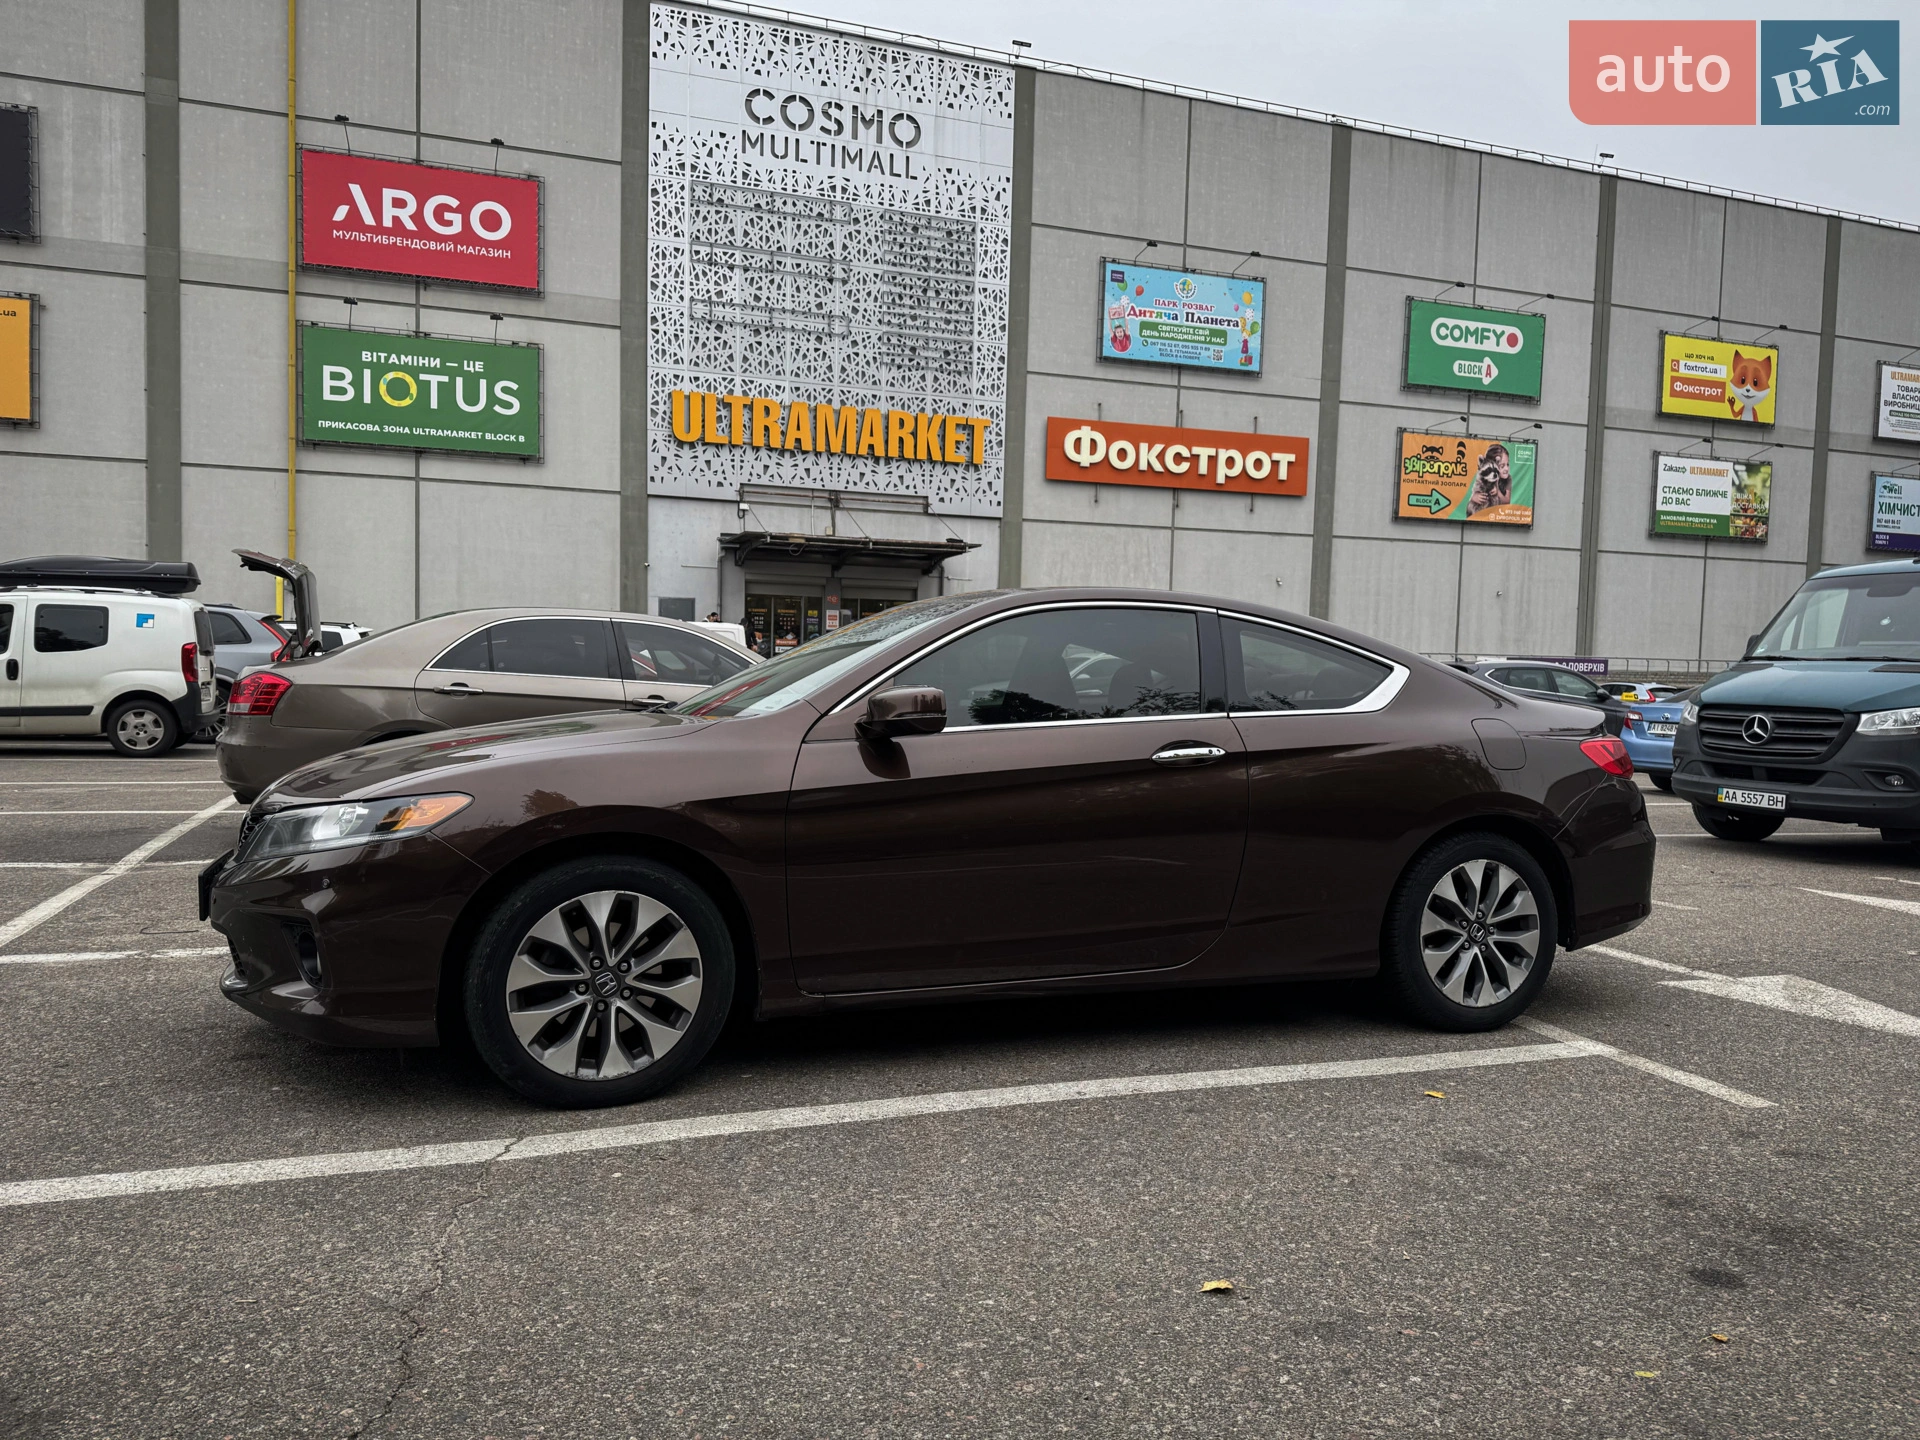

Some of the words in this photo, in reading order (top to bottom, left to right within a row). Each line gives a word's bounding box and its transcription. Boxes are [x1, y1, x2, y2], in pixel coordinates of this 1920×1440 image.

[744, 87, 922, 149] COSMO
[741, 129, 918, 180] MULTIMALL
[332, 183, 512, 241] ARGO
[332, 229, 454, 252] МУЛЬТИБРЕНДОВИЙ
[457, 244, 511, 259] МАГАЗИН
[1154, 298, 1179, 308] ПАРК
[1182, 302, 1215, 313] РОЗВАГ
[1184, 311, 1240, 328] Планета
[1141, 329, 1160, 337] ДЕНЬ
[1160, 331, 1205, 342] НАРОДЖЕННЯ
[1157, 324, 1194, 334] СВЯТКУЙТЕ
[1194, 328, 1210, 336] СВІЙ
[1435, 322, 1506, 347] COMFY
[361, 351, 441, 368] ВІТАМІНИ
[463, 360, 484, 373] ЦЕ
[1458, 362, 1483, 376] BLOCK
[1485, 364, 1492, 378] A
[1683, 362, 1718, 375] foxtrot.ua
[322, 364, 521, 416] BIOTUS
[1673, 381, 1723, 397] Фокстрот
[1892, 392, 1920, 402] ВЛАСНО
[318, 420, 380, 432] ПРИКАСОВА
[383, 425, 410, 435] ЗОНА
[413, 427, 483, 439] ULTRAMARKET
[485, 432, 516, 442] BLOCK
[671, 389, 992, 465] ULTRAMARKET
[1063, 425, 1296, 485] Фокстрот
[1689, 466, 1730, 478] ULTRAMARKET
[1402, 478, 1440, 486] КОНТАКТНИЙ
[1662, 486, 1694, 496] СТАЄМО
[1695, 488, 1728, 499] БЛИЖЧЕ
[1433, 498, 1441, 506] A
[1661, 496, 1674, 506] ДО
[1675, 497, 1691, 506] ВАС
[1568, 662, 1605, 672] ПОВЕРХІВ
[1723, 790, 1737, 802] AA
[1740, 792, 1765, 805] 5557
[1767, 795, 1785, 807] BH
